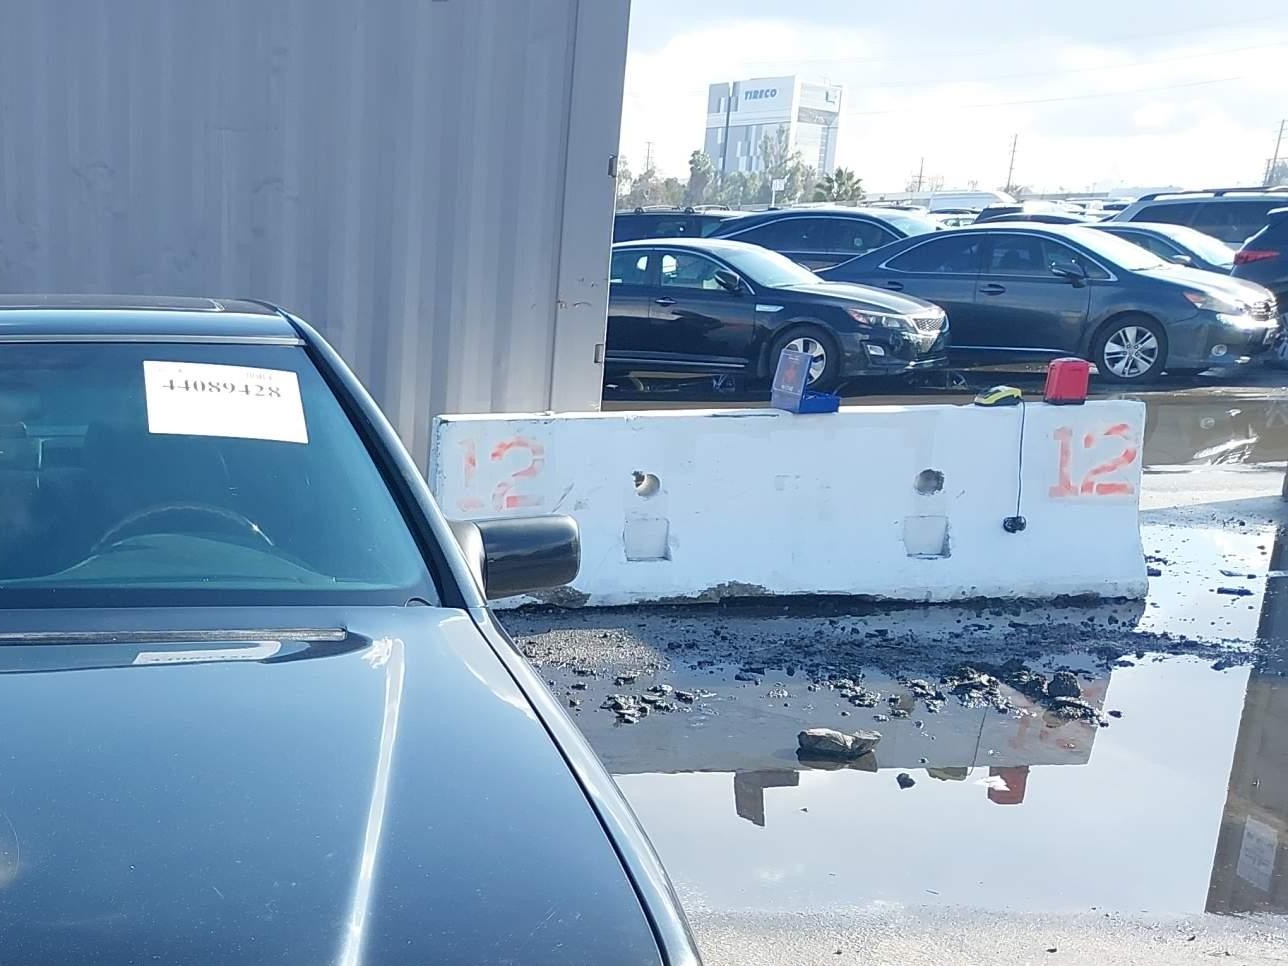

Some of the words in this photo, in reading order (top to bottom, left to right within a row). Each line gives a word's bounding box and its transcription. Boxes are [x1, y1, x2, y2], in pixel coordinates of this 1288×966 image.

[744, 88, 778, 101] TIRECO
[162, 379, 281, 398] 44089428
[456, 436, 545, 512] 12
[1048, 423, 1137, 498] 12
